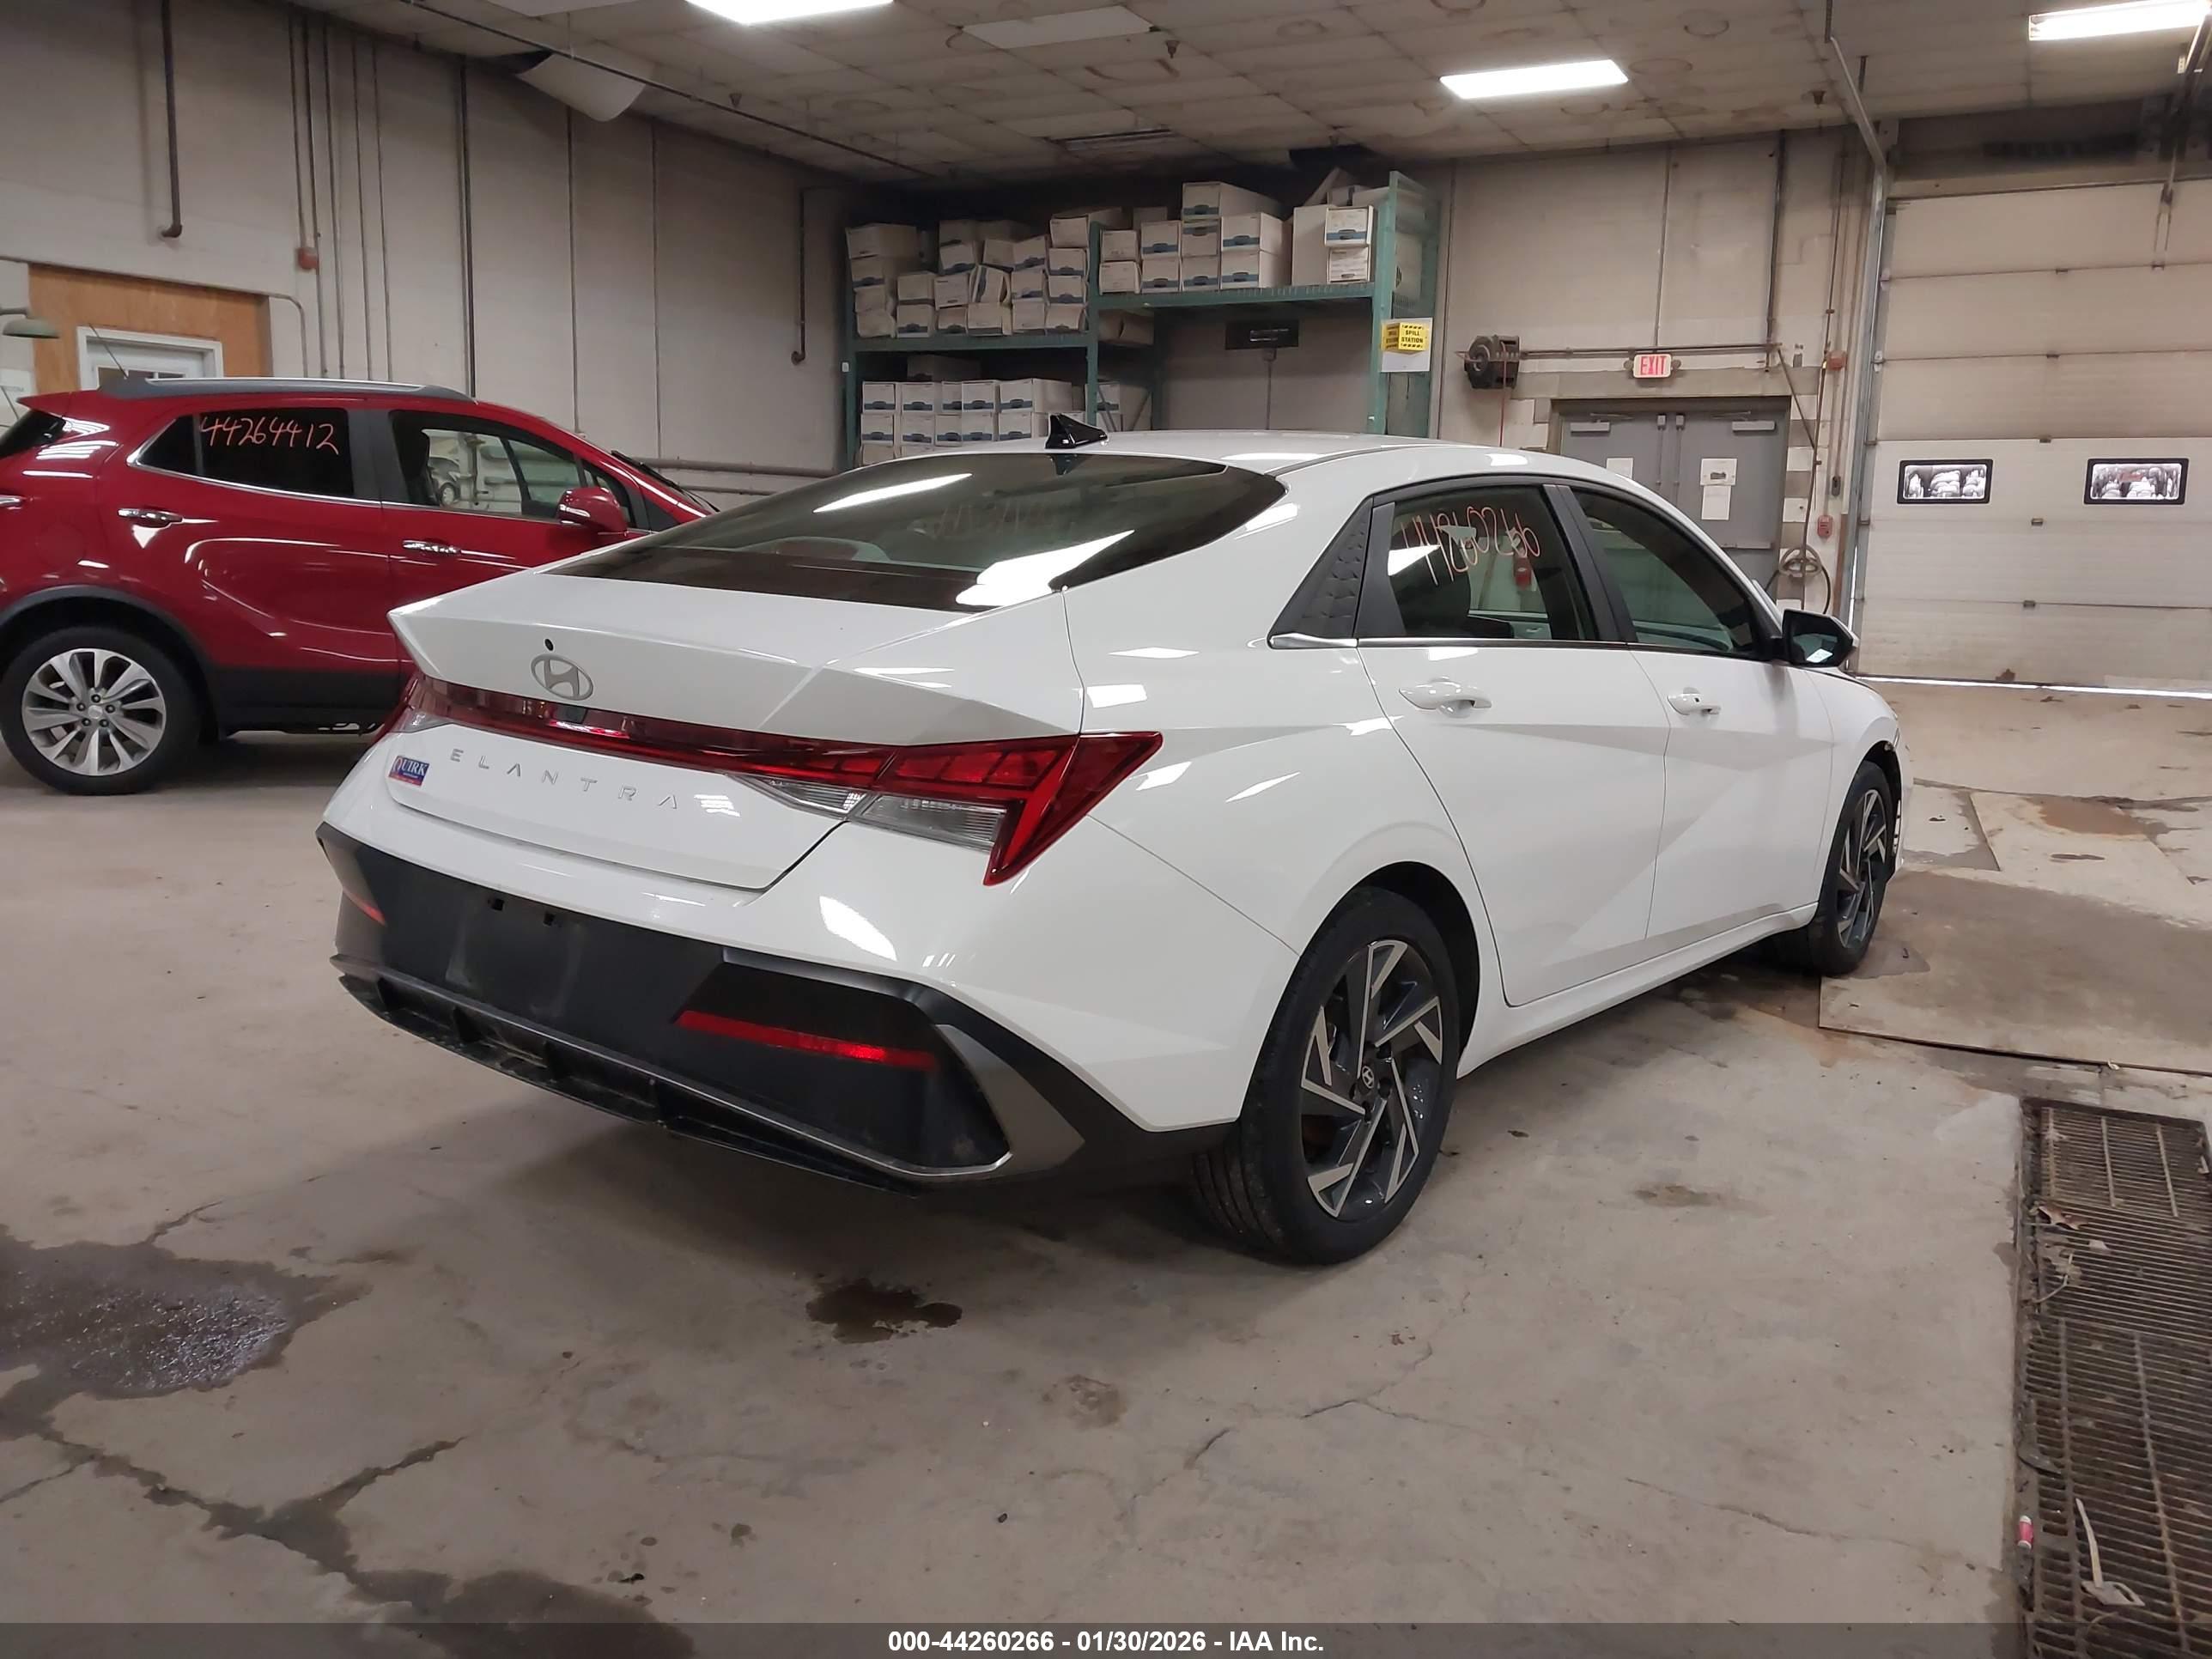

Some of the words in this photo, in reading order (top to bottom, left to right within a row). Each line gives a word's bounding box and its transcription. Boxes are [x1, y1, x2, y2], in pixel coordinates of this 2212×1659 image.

[1640, 356, 1668, 375] EXIT
[200, 416, 339, 455] 44264412
[392, 757, 429, 776] QUIRK
[450, 748, 678, 810] ELANTRA
